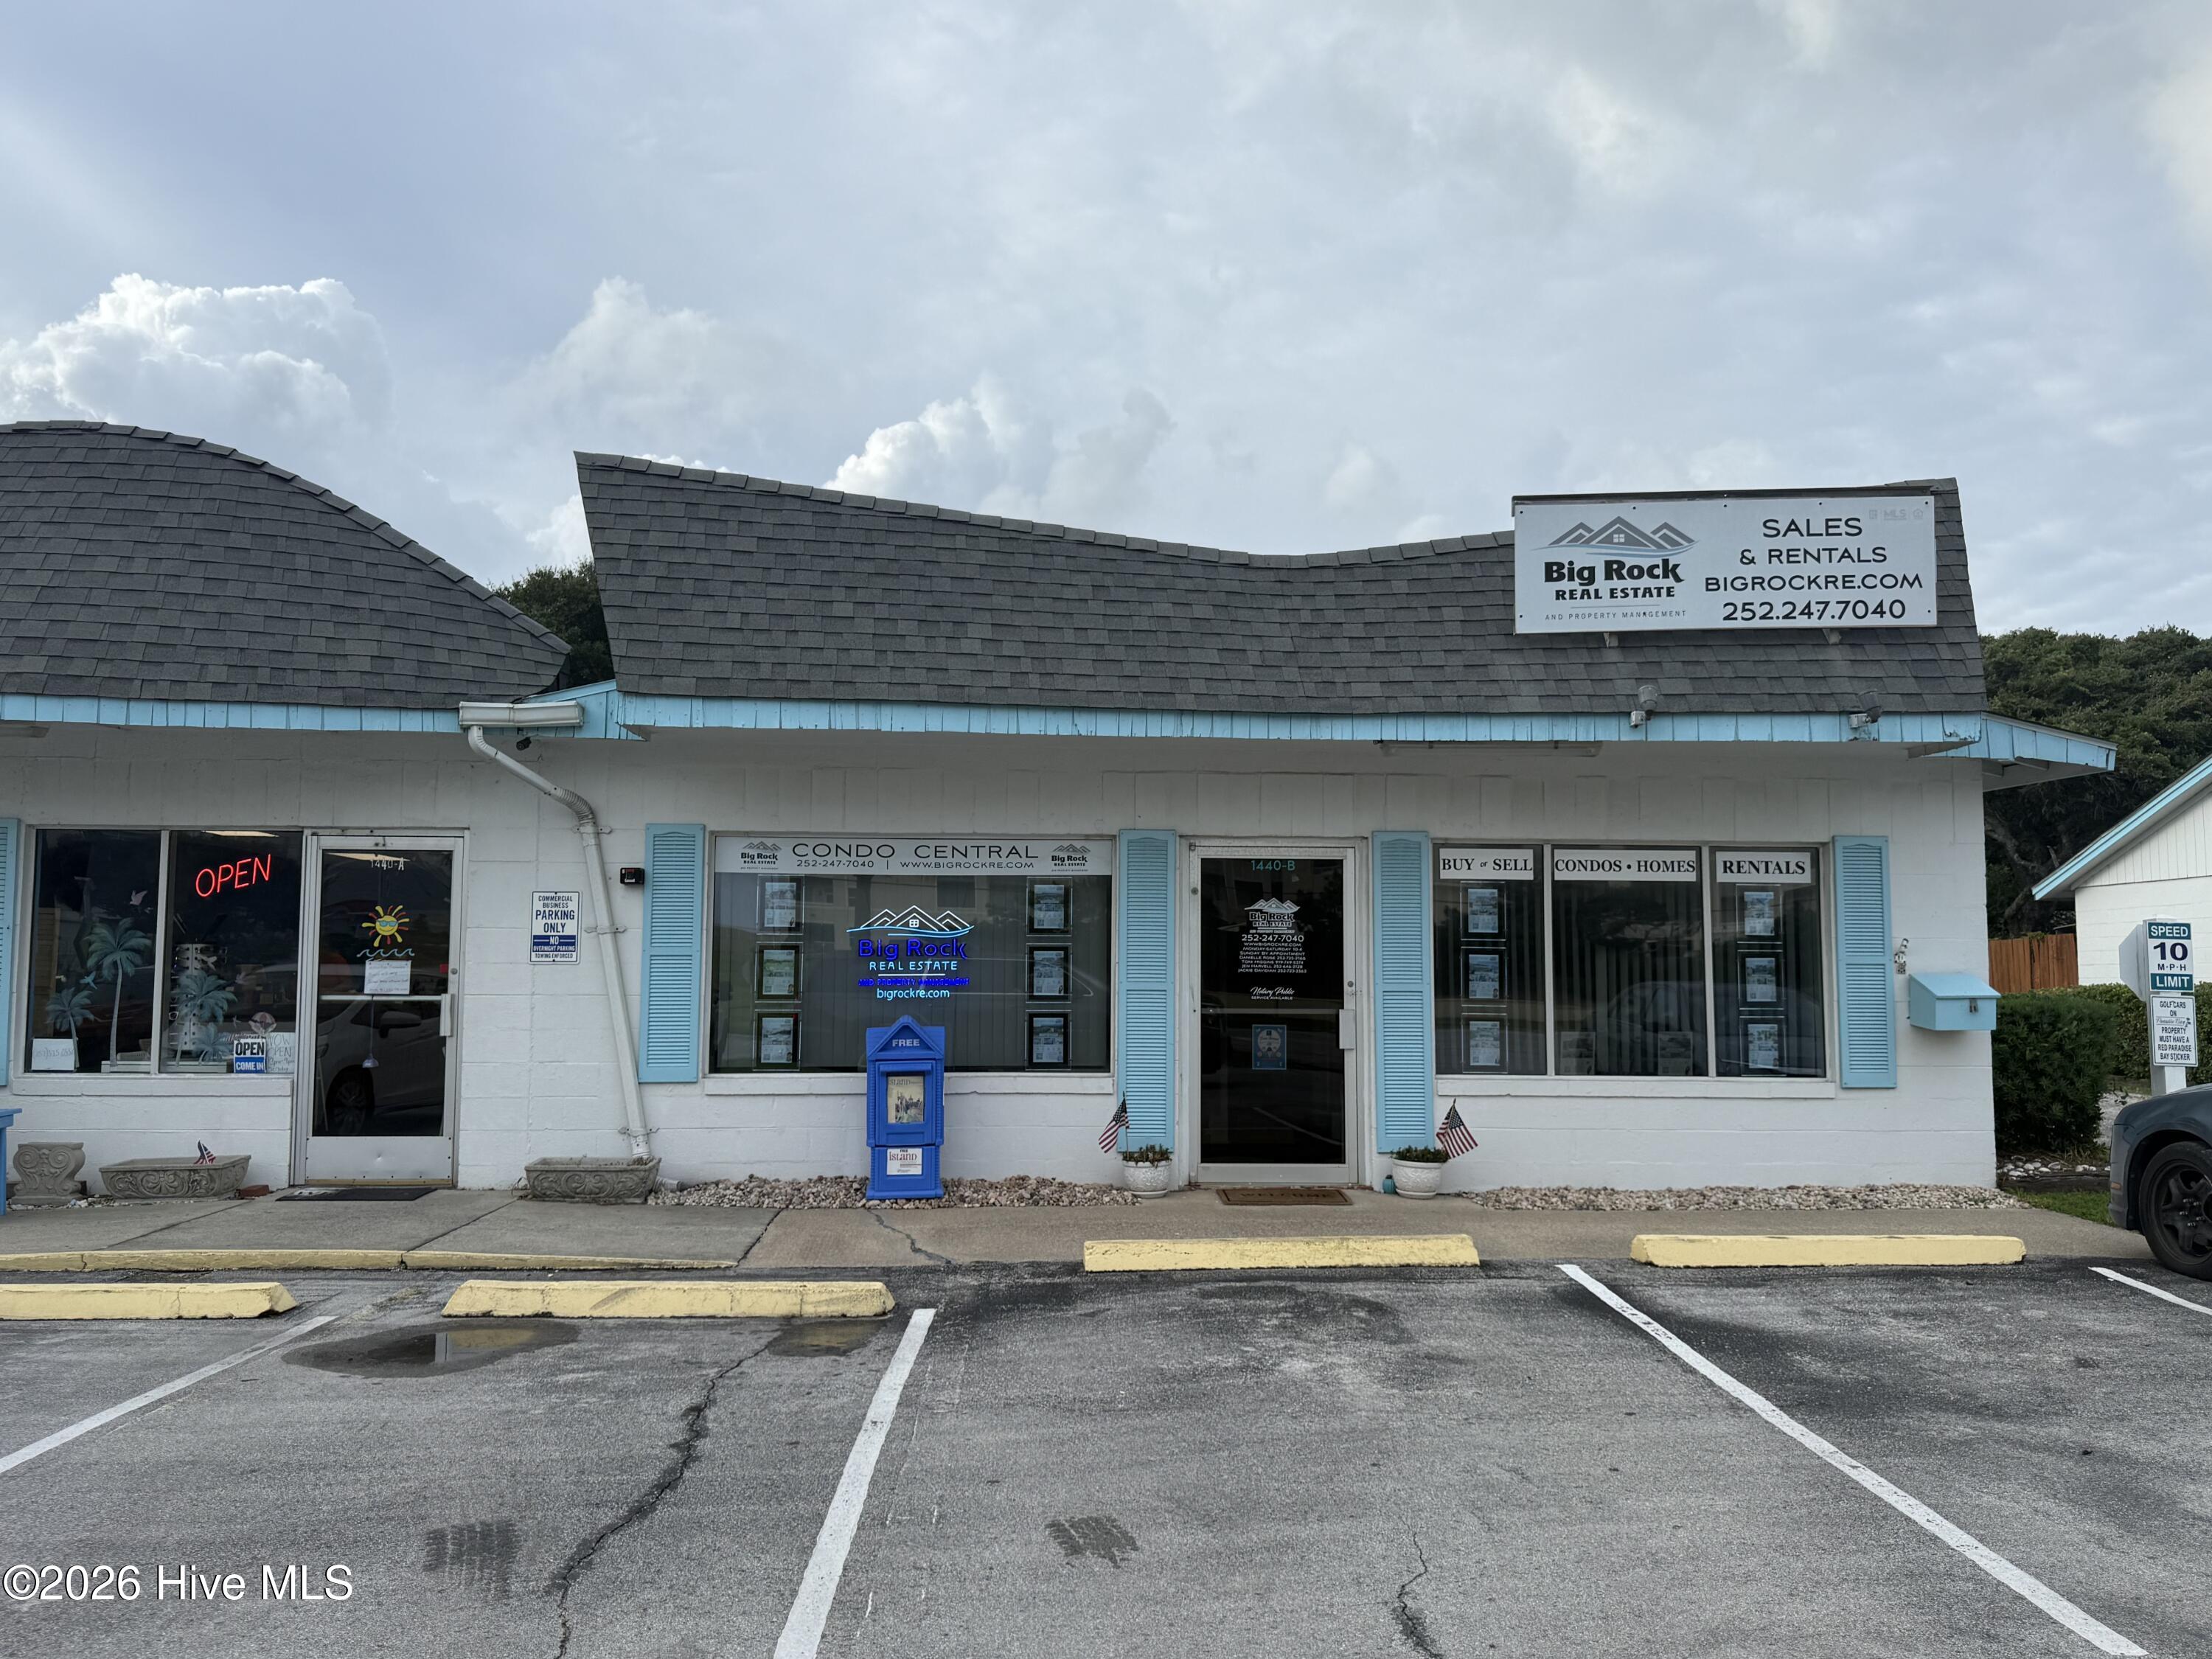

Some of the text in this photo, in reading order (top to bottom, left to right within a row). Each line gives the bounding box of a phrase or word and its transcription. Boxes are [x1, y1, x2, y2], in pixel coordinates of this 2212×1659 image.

[1762, 518, 1863, 538] SALES
[1739, 546, 1888, 566] & RENTALS
[1544, 558, 1686, 587] Big Rock
[1705, 573, 1923, 592] BIGROCKRE.COM
[1555, 586, 1675, 601] REAL ESTATE
[1568, 612, 1617, 620] PROPERTY
[1622, 611, 1686, 619] MANAGEMENT
[1722, 599, 1906, 622] 252.247.7040
[740, 852, 779, 861] Big Rock
[792, 843, 1039, 859] CONDO CENTRAL
[370, 857, 404, 871] 1440-A
[796, 860, 1034, 869] 252-247-7040 WWW.BIGROCKRE.COM
[1251, 860, 1295, 871] 1440-B
[1441, 858, 1475, 871] BUY
[1492, 858, 1533, 872] SELL
[1554, 859, 1696, 873] CONDOS HOMES
[1722, 860, 1806, 874] RENTALS
[195, 854, 271, 897] OPEN
[535, 909, 575, 920] PARKING
[1249, 912, 1295, 922] Big Rock
[543, 922, 566, 933] ONLY
[2151, 925, 2188, 937] SPEED
[549, 936, 560, 945] NO
[858, 938, 967, 961] Big Rock
[2153, 942, 2188, 961] 10
[869, 961, 958, 970] REAL ESTATE
[2156, 975, 2190, 987] LIMIT
[877, 988, 950, 1001] bigrockre.com
[235, 1042, 265, 1056] OPEN
[892, 1038, 920, 1047] FREE
[236, 1062, 264, 1070] COME IN
